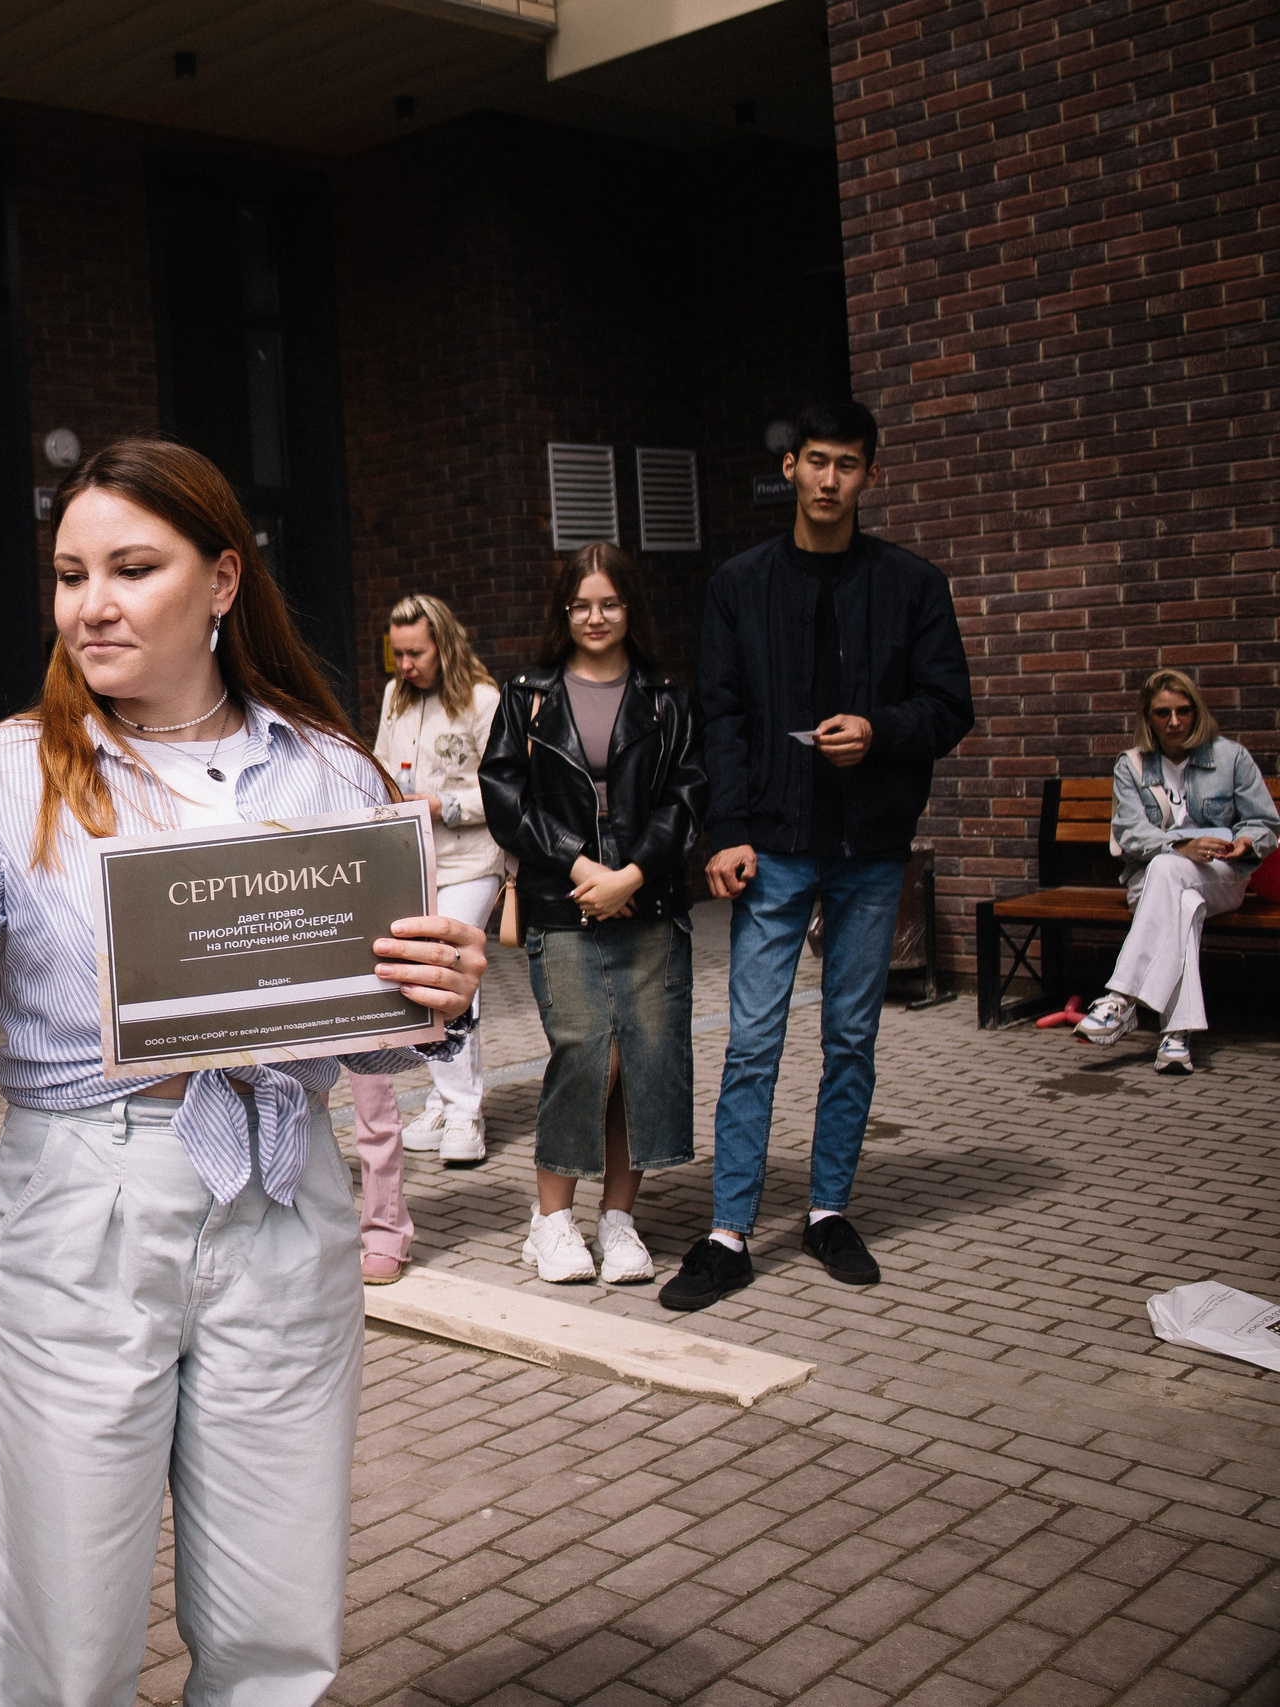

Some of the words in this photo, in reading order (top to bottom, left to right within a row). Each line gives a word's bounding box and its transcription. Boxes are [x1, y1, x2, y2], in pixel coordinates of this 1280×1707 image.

[167, 859, 367, 906] СЕРТИФИКАТ
[188, 918, 293, 942] ПРИОРИТЕТНОЙ
[295, 912, 354, 927] ОЧЕРЕДИ
[237, 911, 265, 925] дает
[268, 908, 305, 920] право
[206, 942, 222, 952] на
[224, 934, 290, 950] получение
[292, 926, 338, 941] ключей
[258, 976, 292, 987] Выдан:
[144, 1037, 165, 1046] ООО
[166, 1036, 177, 1044] СЗ
[240, 1027, 259, 1036] всей
[260, 1025, 283, 1034] души
[283, 1018, 334, 1031] поздравляет
[334, 1016, 350, 1025] Вас
[356, 1008, 406, 1021] новосельем!
